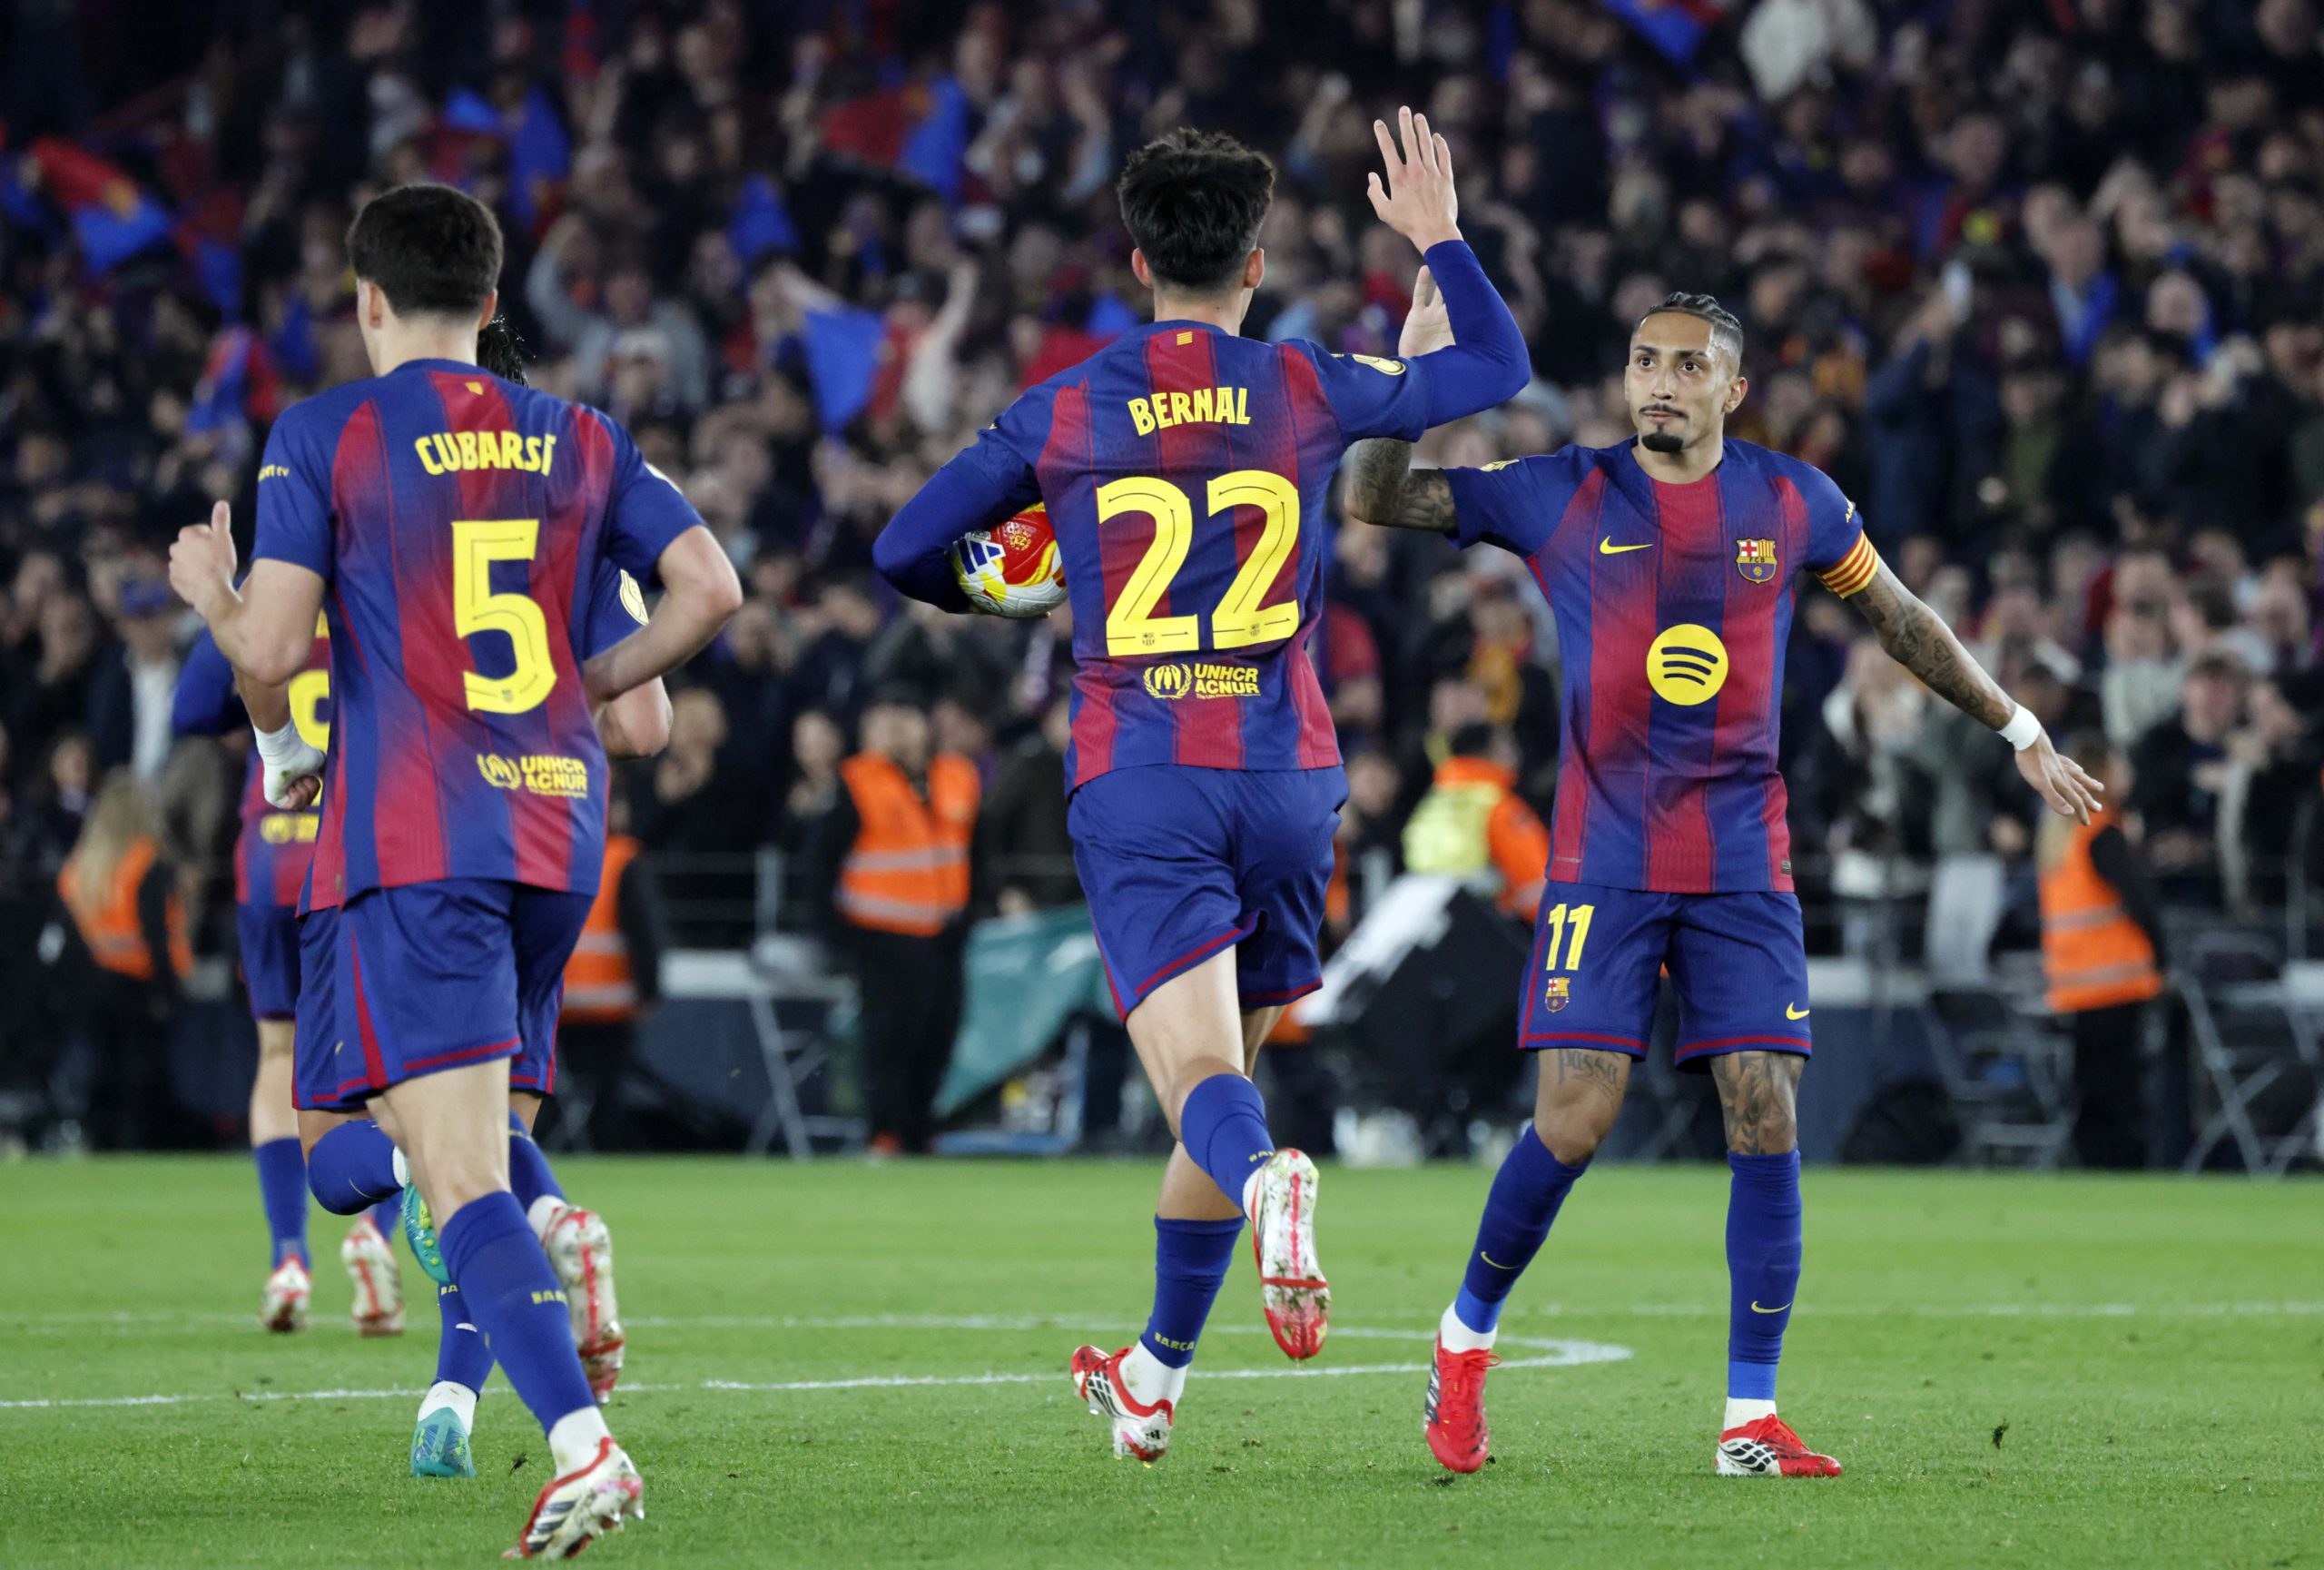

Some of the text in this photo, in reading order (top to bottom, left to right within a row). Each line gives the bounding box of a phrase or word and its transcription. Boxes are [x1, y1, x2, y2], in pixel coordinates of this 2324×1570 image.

[1128, 387, 1251, 436] BERNAL
[1096, 469, 1301, 657] 22
[451, 518, 557, 715] 5
[1194, 663, 1259, 683] UNHCR
[1195, 678, 1260, 696] ACNUR
[520, 755, 587, 775] UNHCR
[525, 772, 588, 792] ACNUR
[1545, 903, 1595, 971] 11
